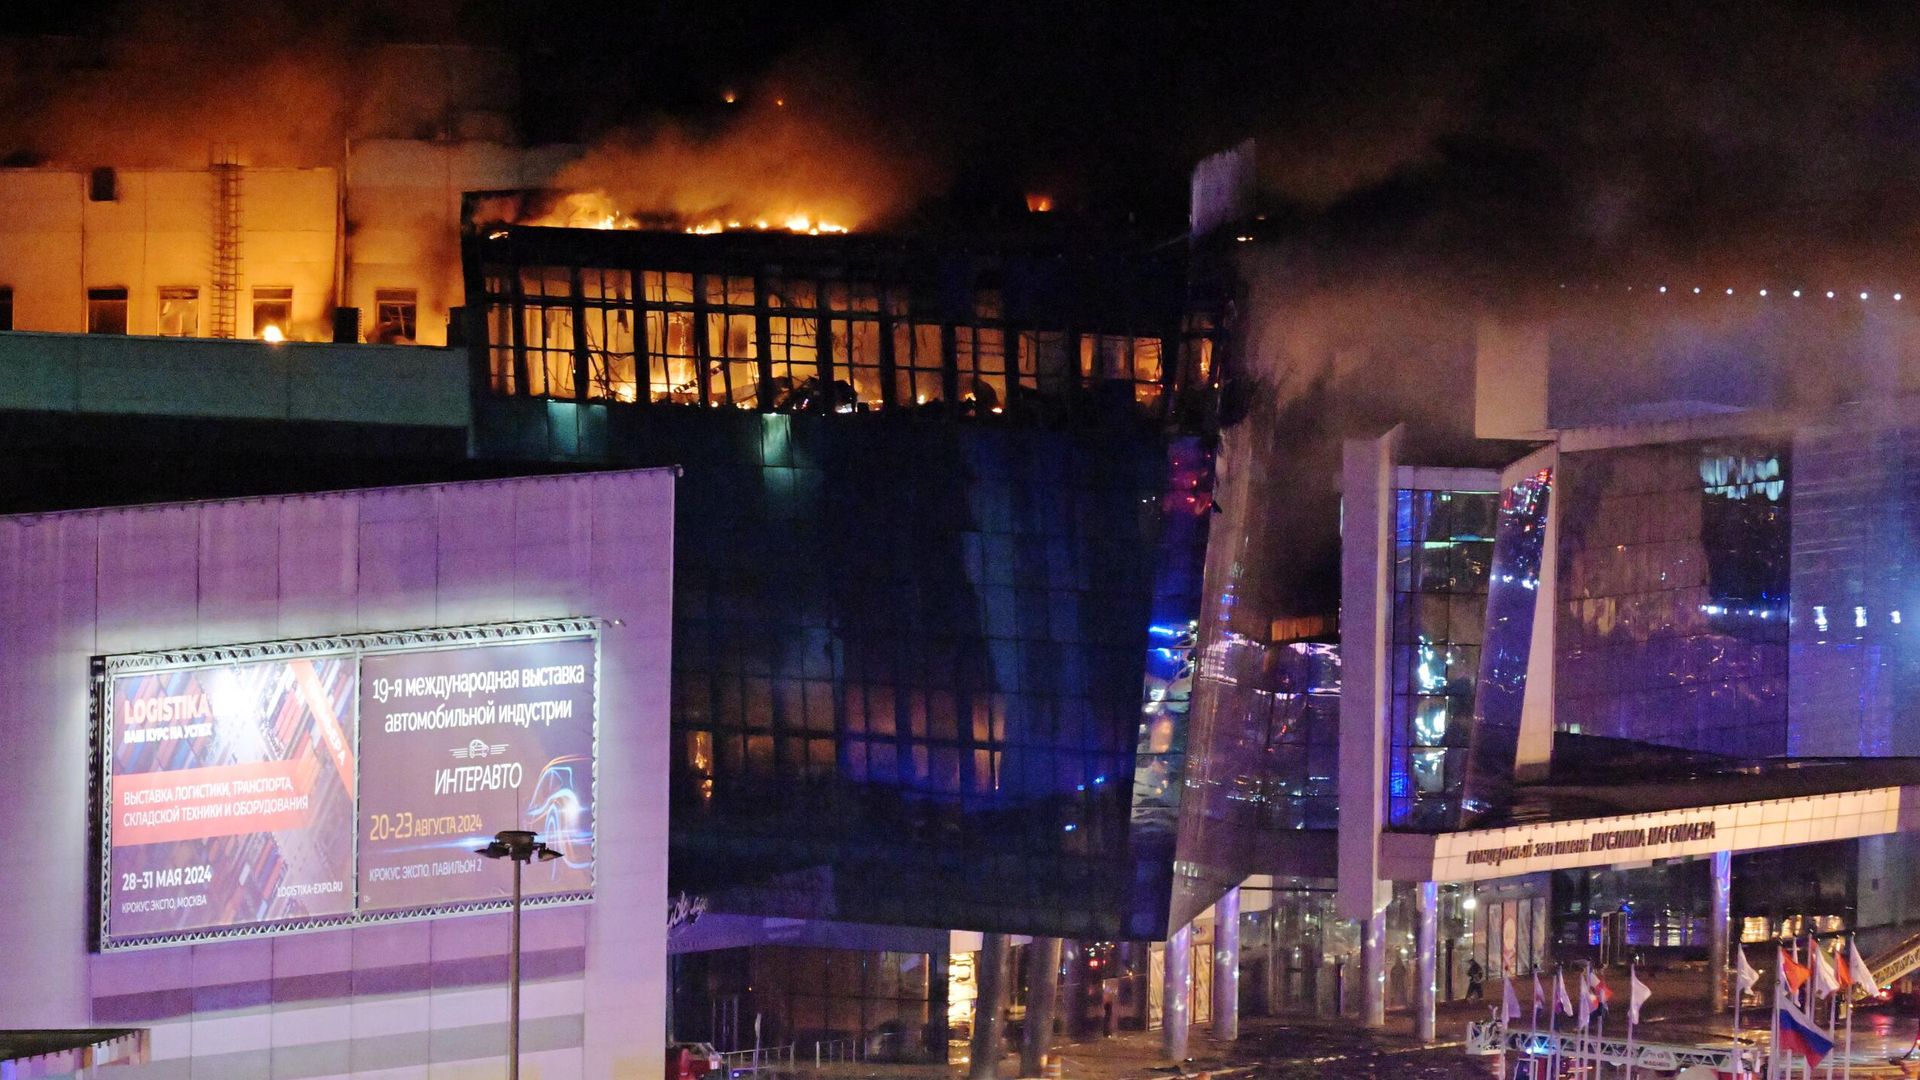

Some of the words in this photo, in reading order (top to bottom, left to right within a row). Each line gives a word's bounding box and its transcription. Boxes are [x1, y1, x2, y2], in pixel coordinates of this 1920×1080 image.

[373, 678, 402, 703] 19-я
[405, 668, 519, 699] международная
[522, 664, 585, 688] выставка
[124, 692, 211, 725] LOGISTIKA
[385, 701, 496, 733] автомобильной
[498, 699, 573, 728] индустрии
[123, 789, 172, 806] ВЫСТАВКА
[174, 784, 231, 802] ЛОГИСТИКИ,
[232, 776, 293, 795] ТРАНСПОРТА,
[434, 763, 522, 795] ИНТЕРАВТО
[123, 807, 180, 827] СКЛАДСКОЙ
[182, 803, 222, 821] ТЕХНИКИ
[224, 806, 231, 817] И
[232, 795, 309, 817] ОБОРУДОВАНИЯ
[370, 812, 413, 841] 20-23
[414, 816, 457, 837] АВГУСТА
[457, 814, 483, 833] 2024
[1591, 828, 1645, 851] МУСЛИМА
[1648, 821, 1716, 846] МАГОМАЕВА
[156, 867, 182, 888] МАЯ
[184, 864, 212, 885] 2024
[368, 866, 401, 882] КРОКУС
[432, 860, 476, 876] ПАВИЛЬОН
[476, 858, 482, 872] 2
[277, 880, 343, 897] LOGISTIKA-EXPO.RU
[122, 900, 150, 914] КРОКУС
[177, 894, 207, 909] МОСКВА
